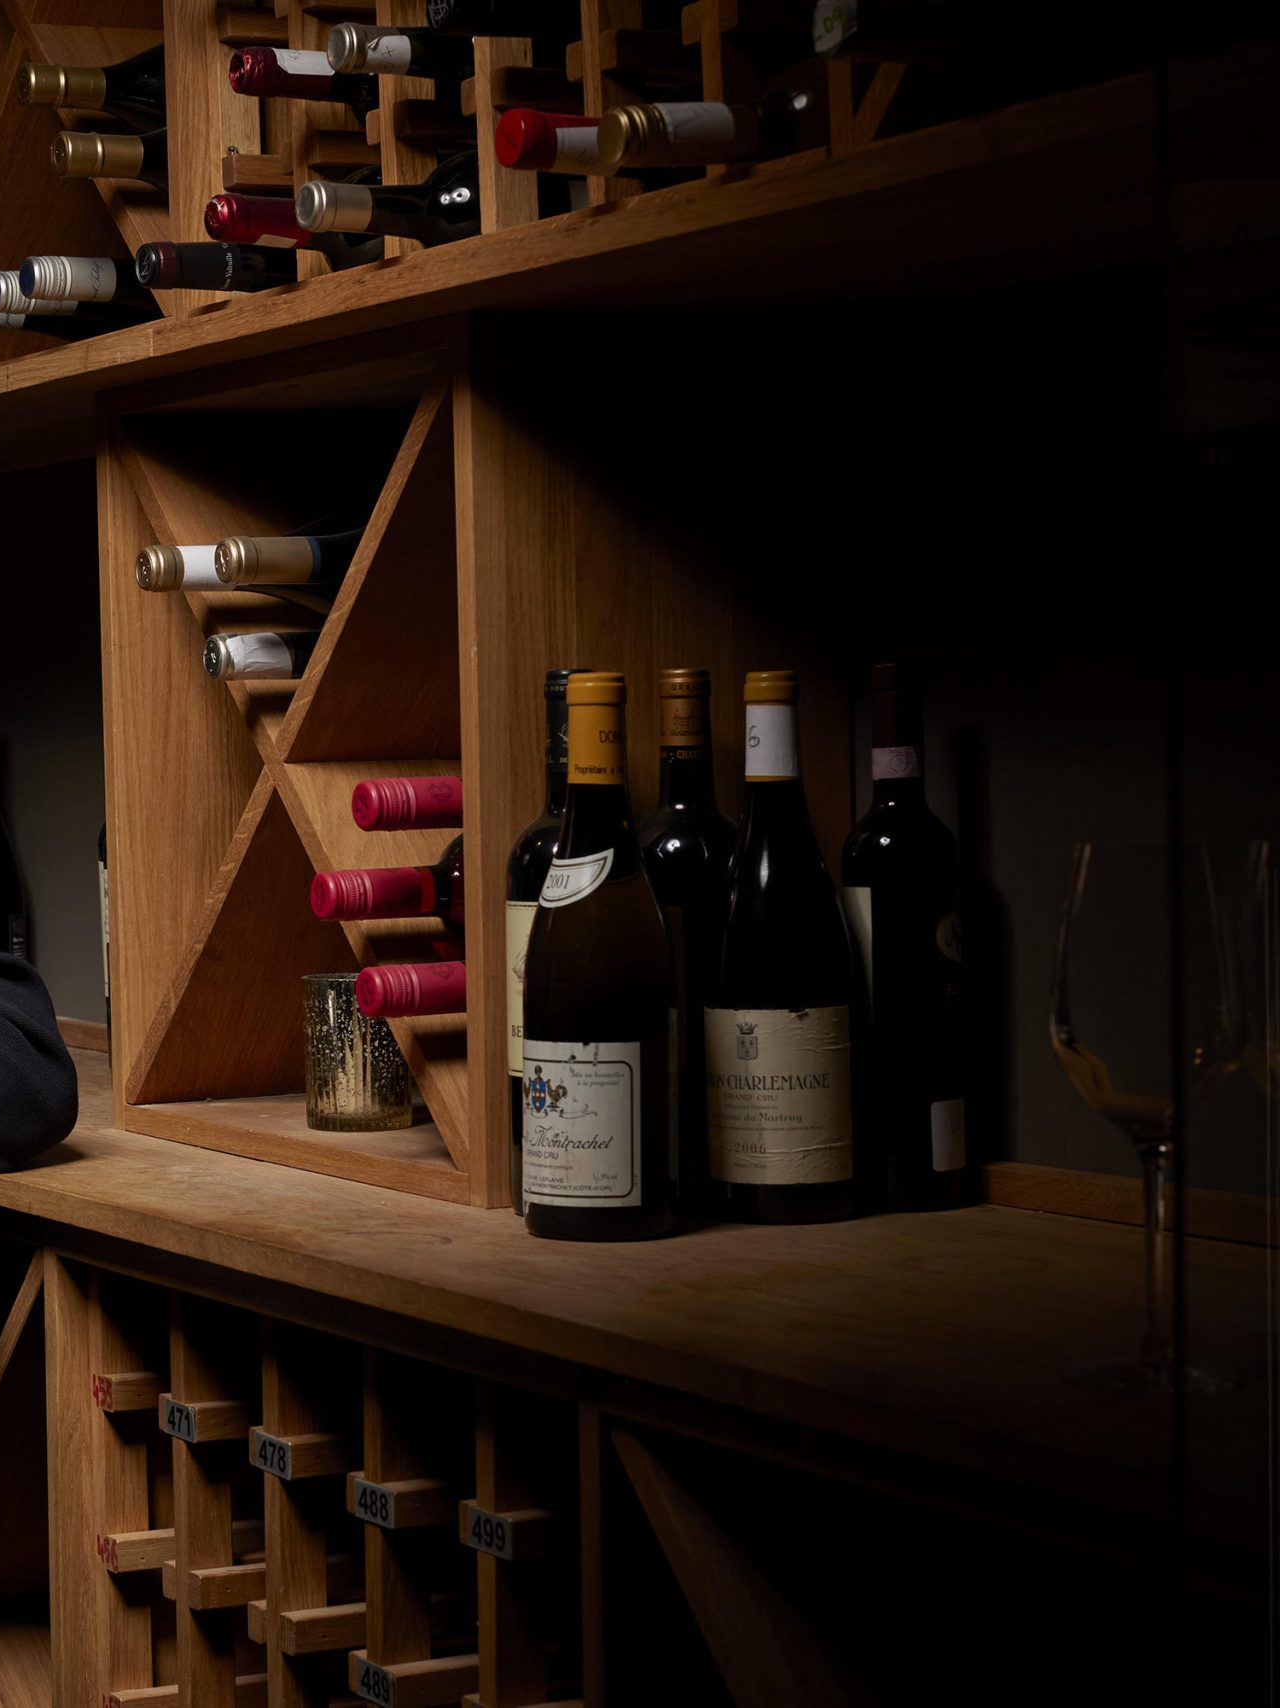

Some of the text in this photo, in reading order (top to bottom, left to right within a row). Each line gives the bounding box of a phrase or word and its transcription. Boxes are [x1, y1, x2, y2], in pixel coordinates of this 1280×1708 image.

[733, 1142, 767, 1154] 2006
[167, 1404, 192, 1437] 471
[259, 1438, 287, 1474] 478
[358, 1486, 389, 1523] 488
[472, 1514, 506, 1551] 499
[360, 1666, 390, 1703] 489
